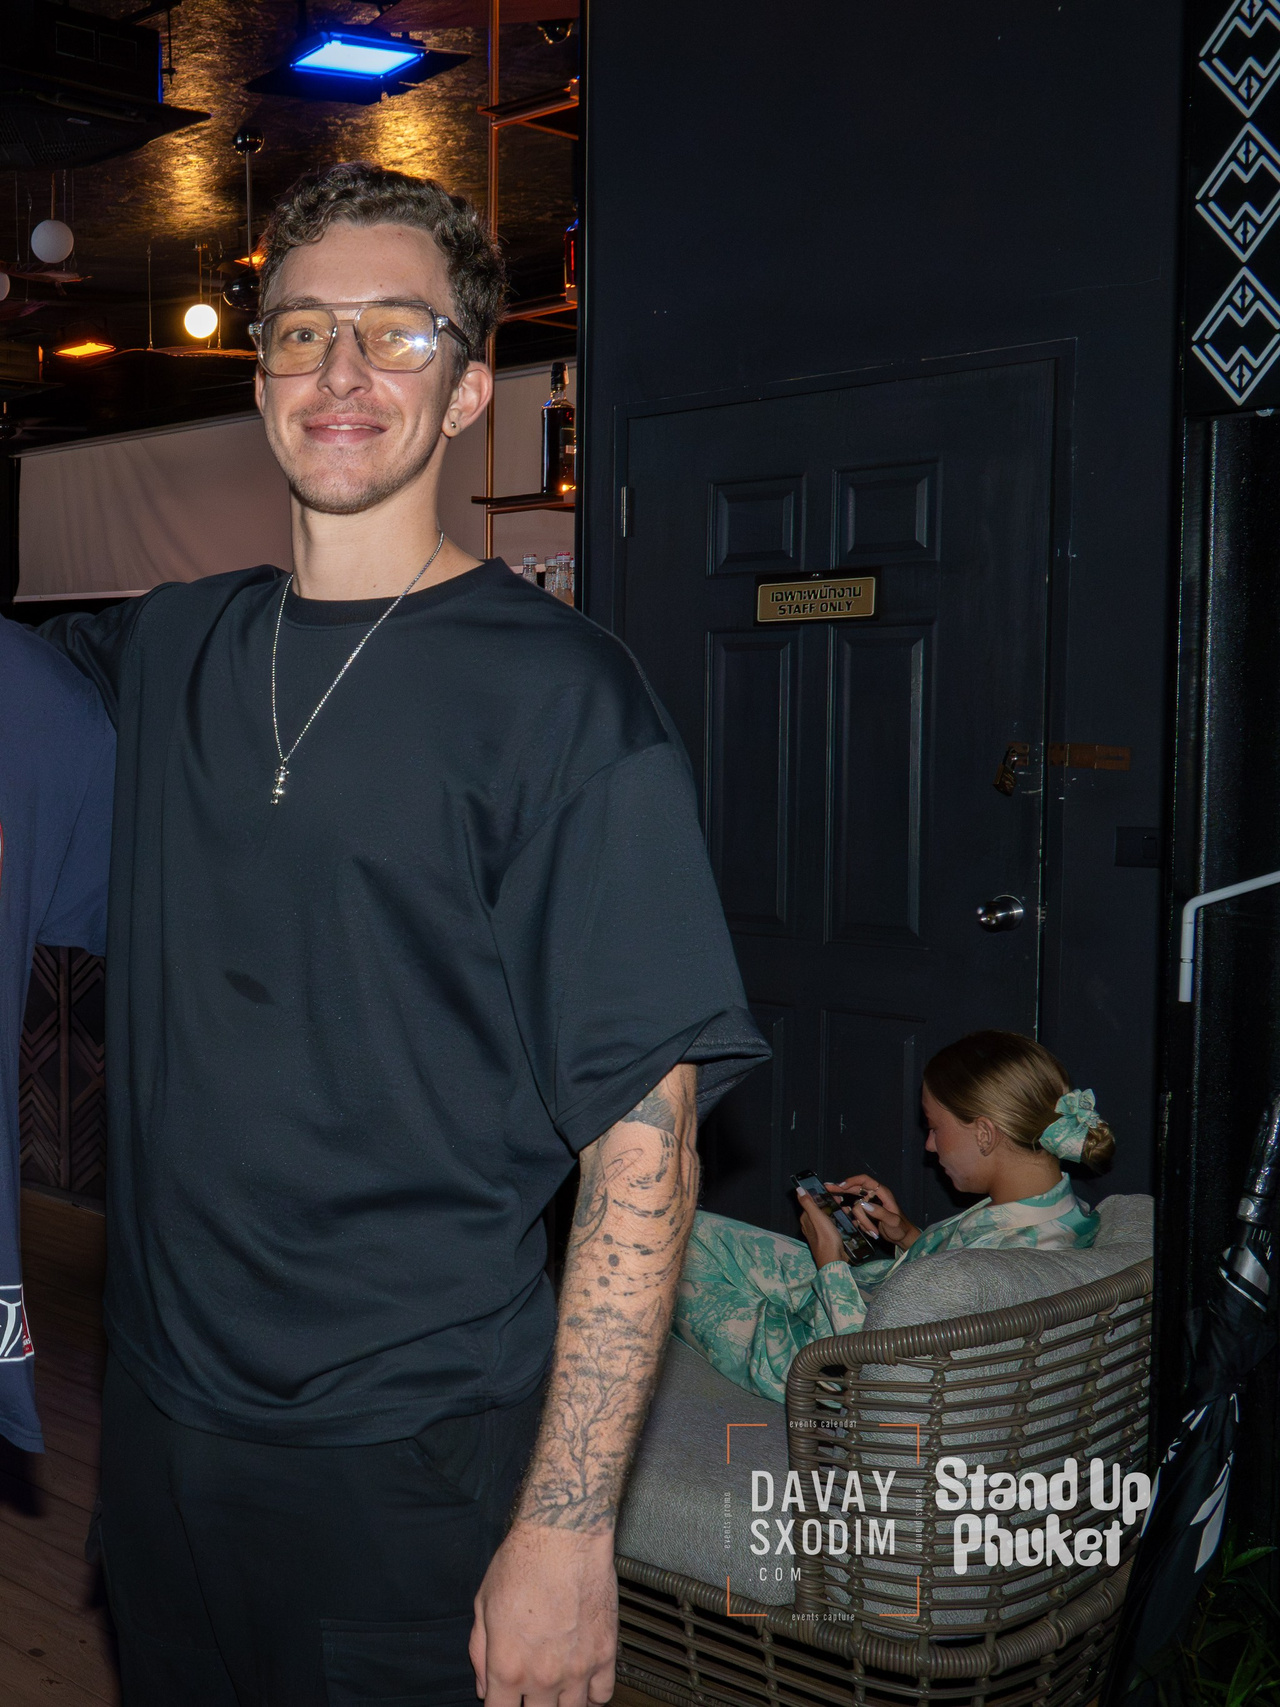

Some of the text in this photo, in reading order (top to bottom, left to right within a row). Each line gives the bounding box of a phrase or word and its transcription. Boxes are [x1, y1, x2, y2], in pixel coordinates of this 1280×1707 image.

[771, 585, 862, 603] เฉพาะพนักงาน
[778, 601, 853, 615] STAFF ONLY
